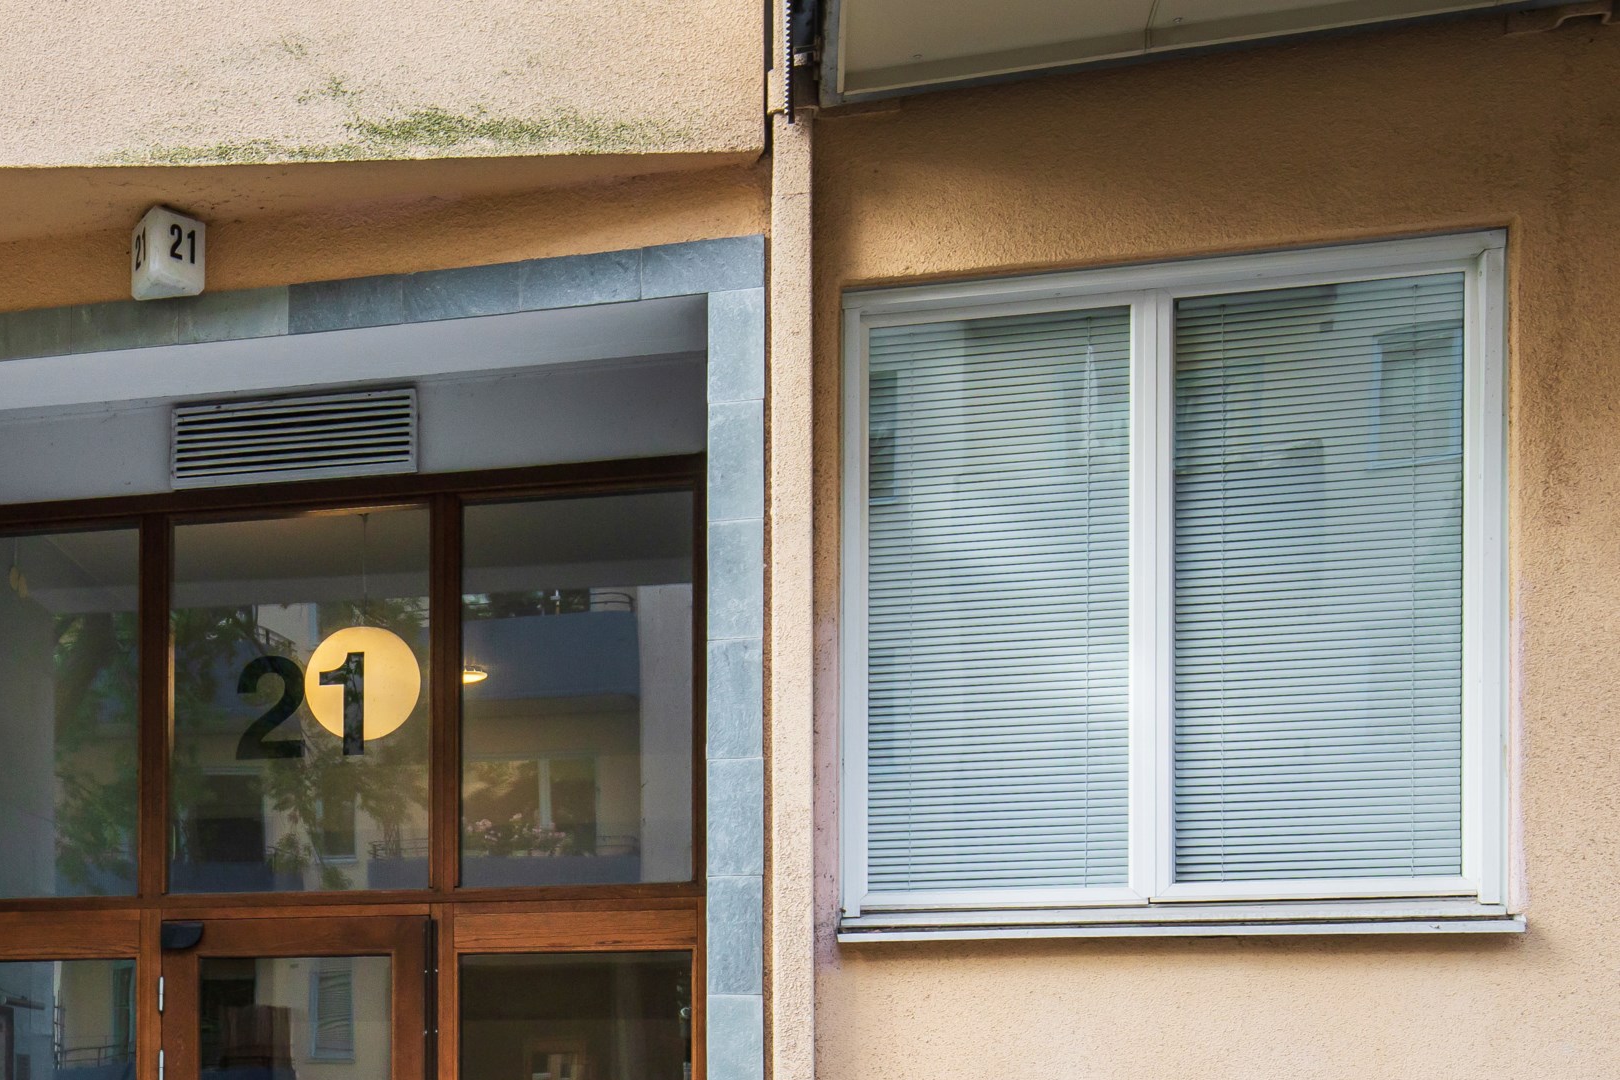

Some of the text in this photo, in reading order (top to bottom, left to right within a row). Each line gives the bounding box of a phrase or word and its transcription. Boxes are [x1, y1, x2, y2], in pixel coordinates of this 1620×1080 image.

[135, 226, 146, 271] 21
[169, 223, 196, 265] 21
[236, 651, 365, 760] 21
